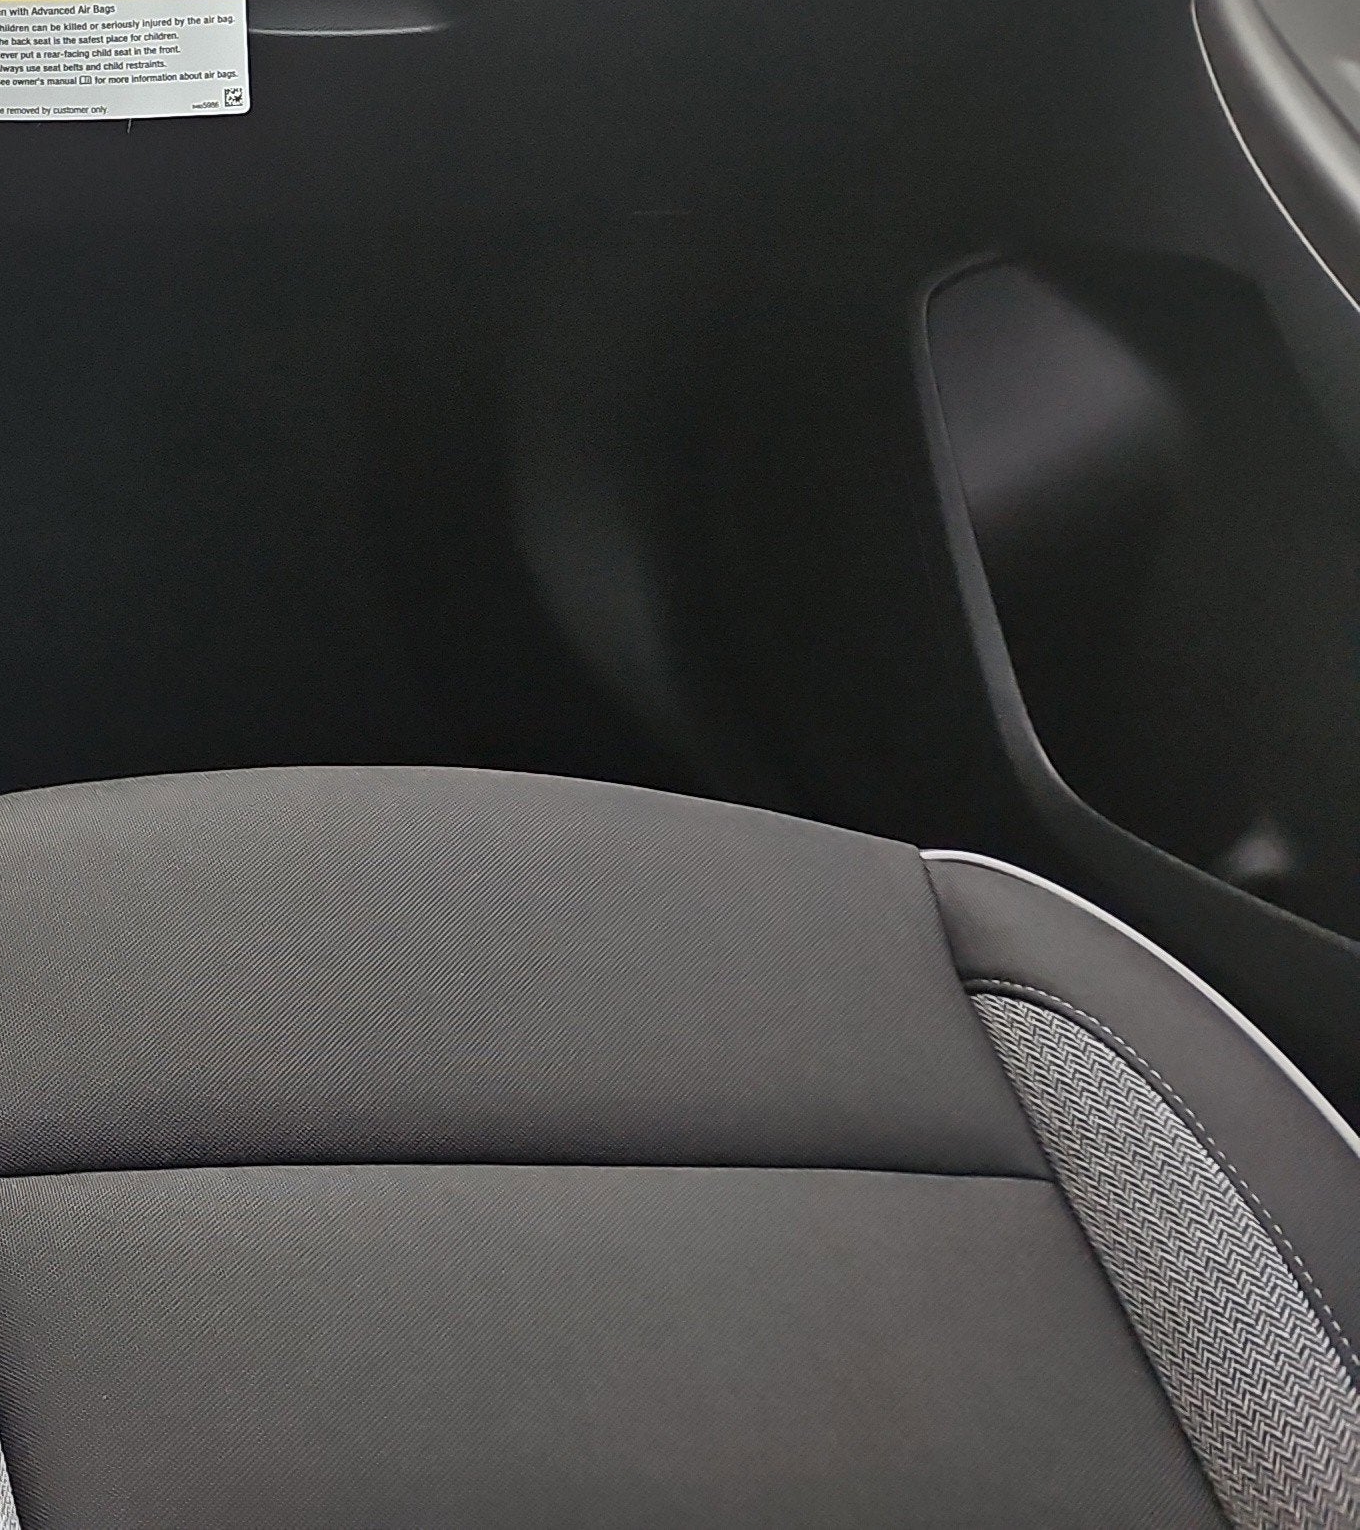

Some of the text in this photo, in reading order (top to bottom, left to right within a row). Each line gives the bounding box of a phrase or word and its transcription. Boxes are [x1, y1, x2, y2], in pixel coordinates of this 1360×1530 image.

[9, 7, 29, 16] with
[31, 6, 76, 16] Advanced
[77, 5, 91, 14] Air
[93, 4, 116, 15] Bags
[31, 24, 48, 32] can
[50, 23, 61, 31] be
[63, 22, 88, 31] killed
[101, 20, 140, 30] seriously
[142, 17, 172, 28] injured
[174, 17, 185, 27] by
[187, 17, 201, 25] the
[203, 16, 215, 24] air
[217, 15, 235, 25] bag.
[11, 37, 31, 45] back
[33, 37, 51, 45] seat
[53, 37, 61, 45] is
[78, 36, 104, 44] safest
[106, 34, 128, 44] place
[130, 33, 142, 41] for
[144, 32, 179, 41] children.
[20, 51, 34, 60] put
[43, 50, 89, 59] rear-facing
[92, 48, 112, 57] child
[114, 48, 132, 56] seat
[134, 47, 141, 55] in
[143, 46, 157, 54] the
[159, 45, 181, 54] front.
[43, 64, 61, 72] seat
[63, 63, 84, 71] belts
[86, 63, 101, 71] and
[103, 61, 123, 70] child
[126, 60, 168, 69] restraints.
[12, 77, 45, 85] owner's
[47, 77, 77, 85] manual
[94, 76, 106, 84] for
[131, 73, 177, 83] information
[180, 72, 203, 80] about
[204, 71, 215, 79] air
[217, 70, 238, 79] bags.
[6, 106, 40, 114] removed
[41, 106, 51, 116] by
[53, 106, 89, 114] customer
[91, 105, 108, 116] only.
